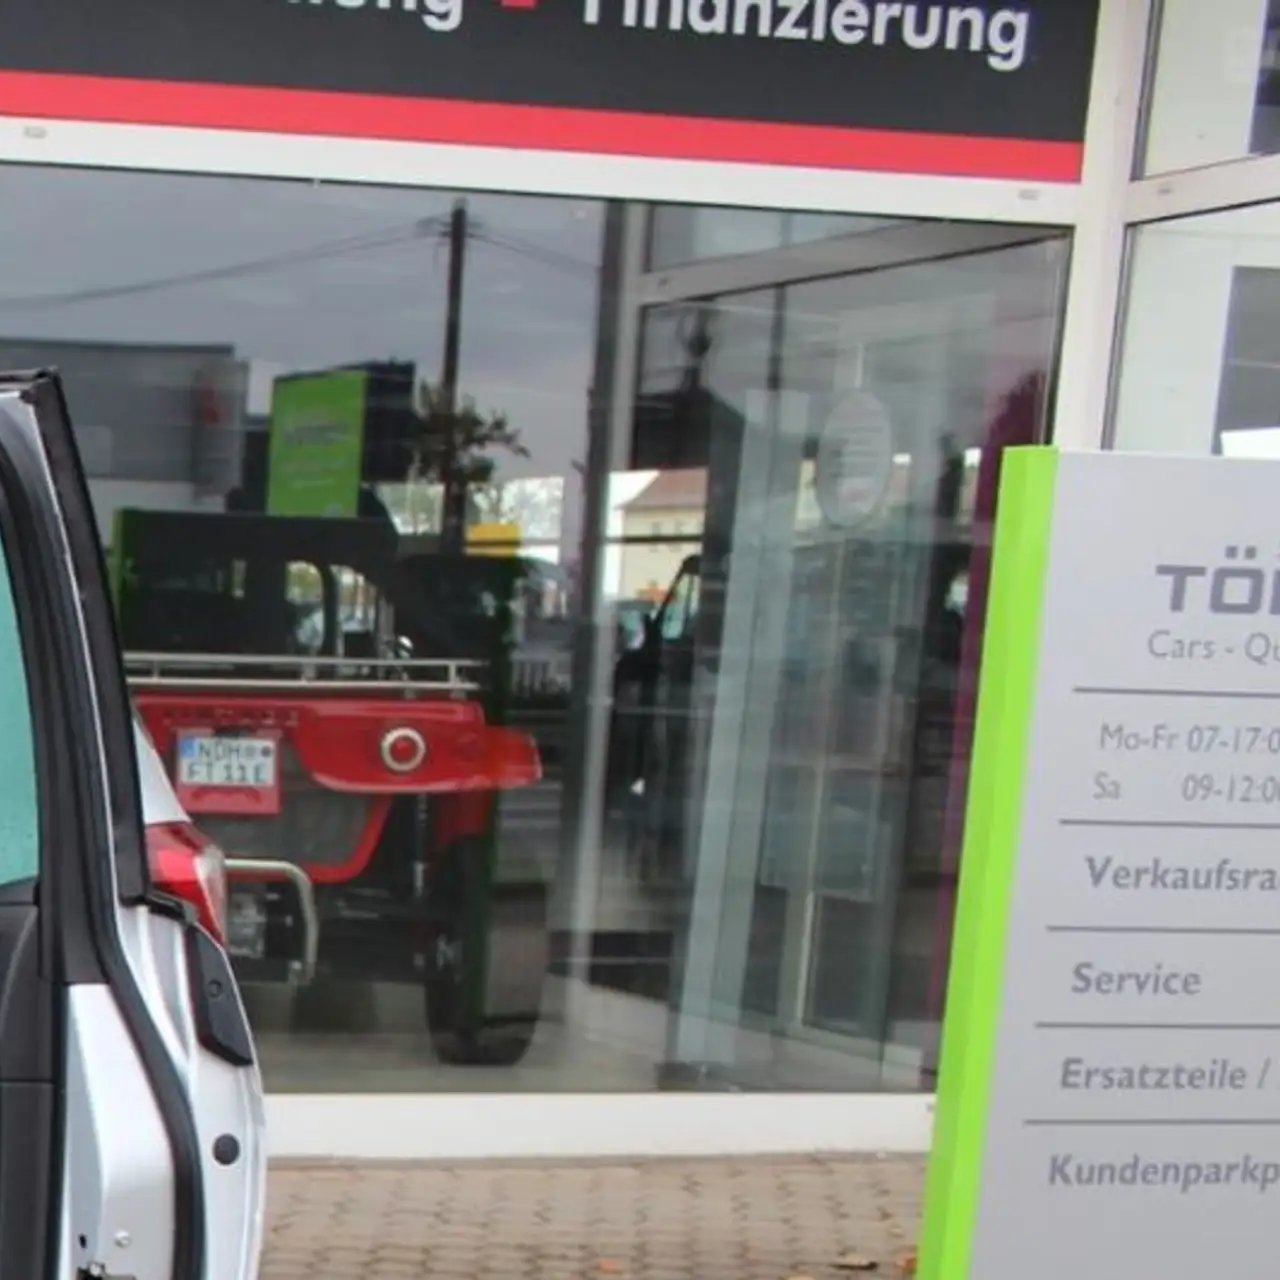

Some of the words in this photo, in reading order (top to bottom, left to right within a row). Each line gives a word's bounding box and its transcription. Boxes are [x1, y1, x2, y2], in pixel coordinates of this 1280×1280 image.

[1155, 545, 1280, 615] TÖ
[1148, 629, 1216, 660] Cars
[1100, 722, 1179, 750] Mo-Fr
[1093, 770, 1121, 800] Sa
[1182, 773, 1280, 803] 09-12:0
[1085, 855, 1278, 892] Verkaufsra
[1071, 961, 1203, 996] Service
[1059, 1055, 1248, 1089] Ersatzteile
[1048, 1152, 1280, 1194] Kundenparkp
